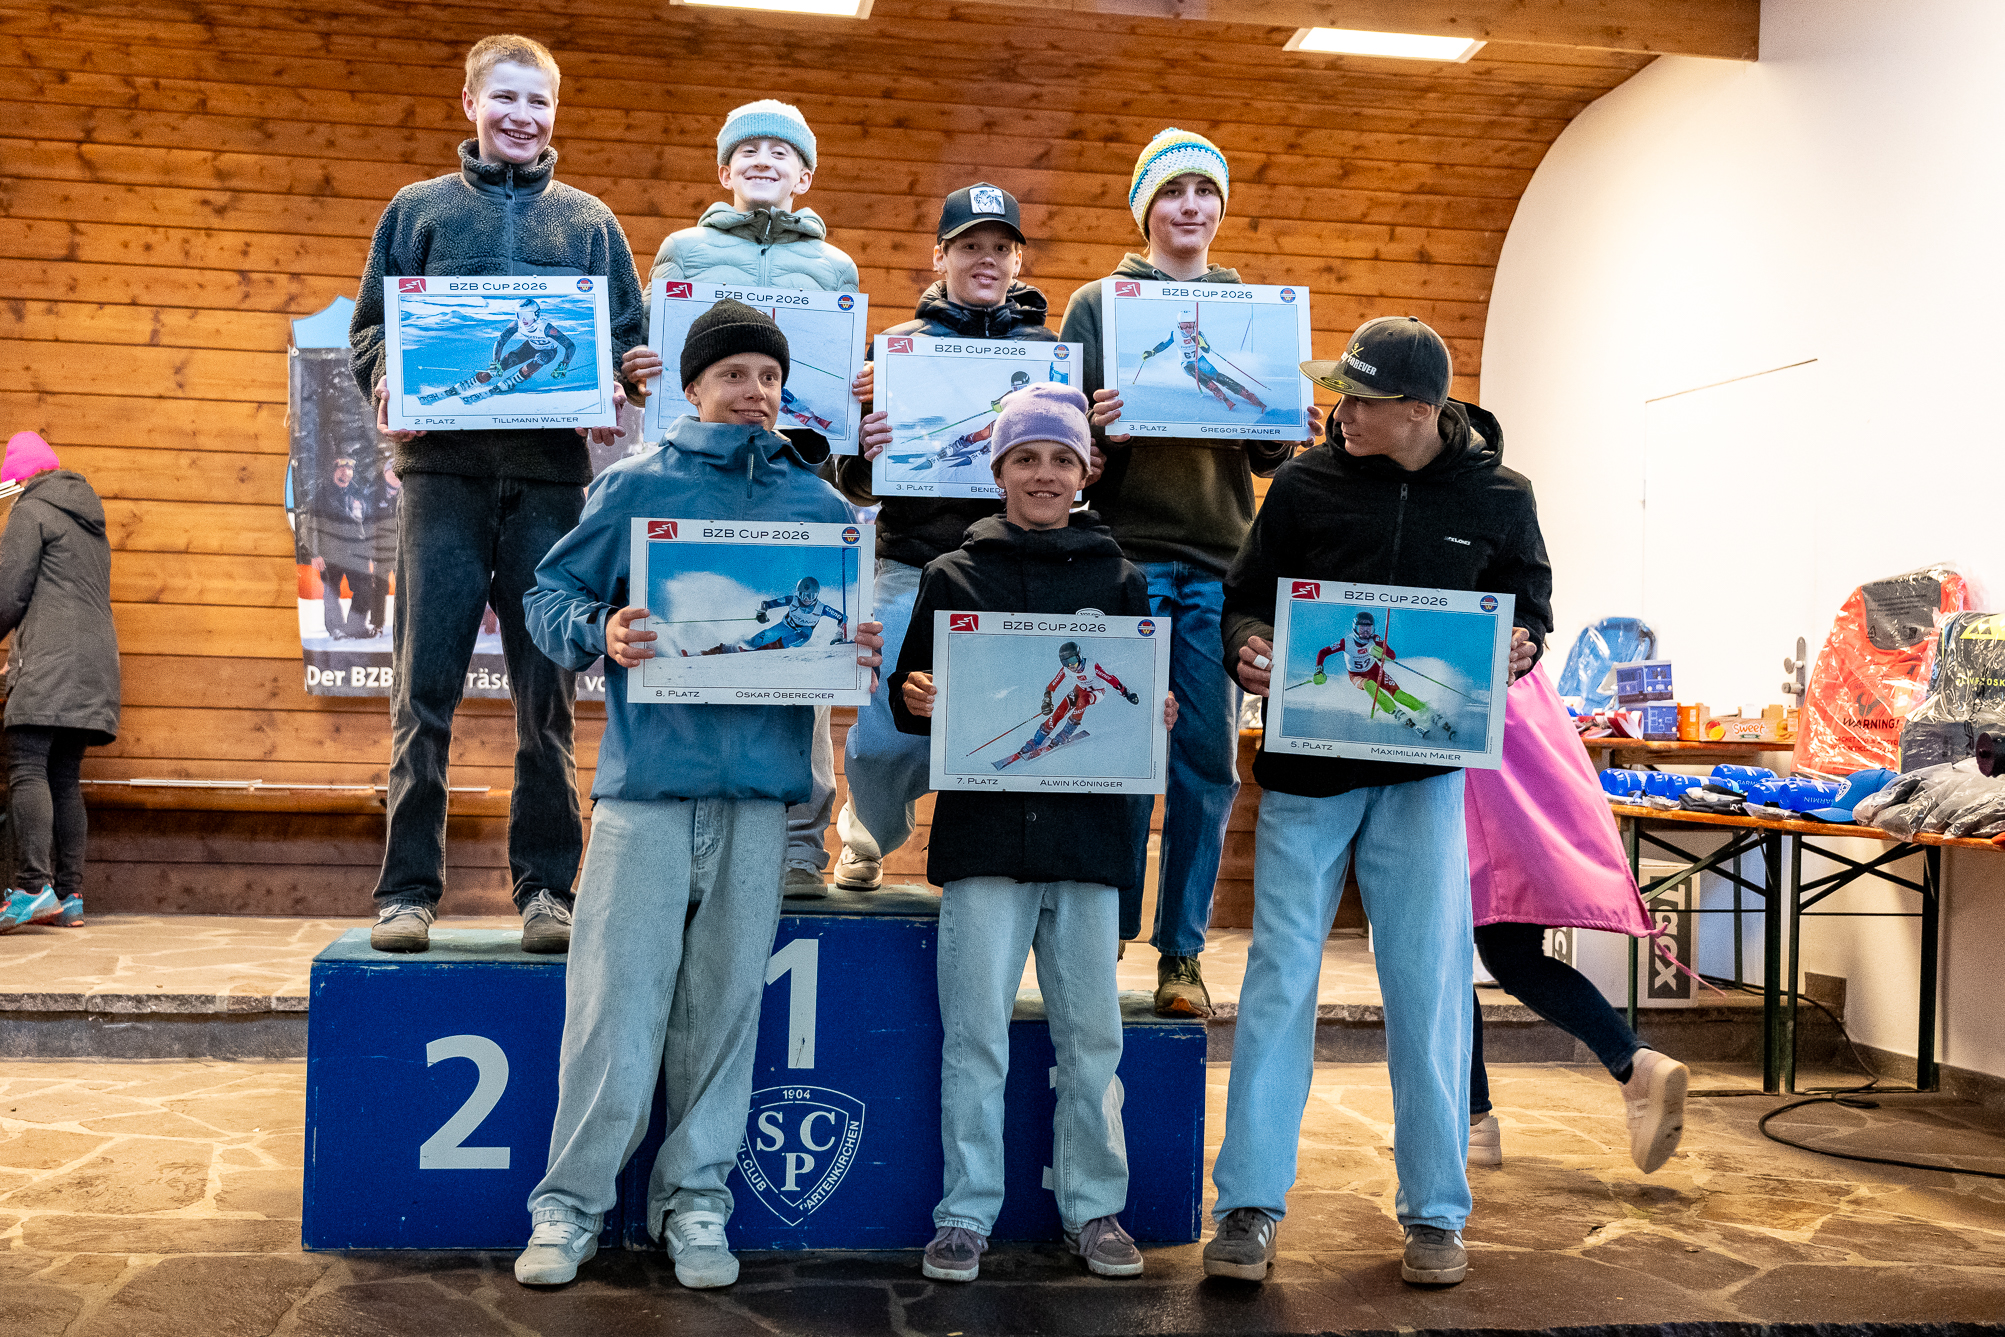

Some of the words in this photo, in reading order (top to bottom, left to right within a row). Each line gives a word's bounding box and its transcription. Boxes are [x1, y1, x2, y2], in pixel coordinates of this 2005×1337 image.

[449, 282, 479, 291] BZB
[482, 282, 510, 291] CUP
[513, 282, 548, 291] 2026
[714, 290, 743, 300] BZB
[746, 292, 774, 302] CUP
[776, 294, 810, 305] 2026
[1162, 288, 1189, 297] BZB
[1193, 289, 1219, 298] CUP
[1220, 290, 1253, 299] 2026
[934, 344, 962, 353] BZB
[965, 345, 992, 354] CUP
[993, 346, 1027, 356] 2026
[1347, 356, 1378, 376] FOREVER
[493, 416, 539, 424] TILLMANN
[540, 415, 579, 423] WALTER
[1200, 426, 1239, 434] GREGOR
[1240, 427, 1281, 435] STAUNER
[970, 486, 1002, 494] BENED
[703, 528, 735, 538] BZB
[739, 529, 769, 539] CUP
[772, 530, 810, 540] 2026
[1344, 590, 1375, 601] BZB
[1379, 592, 1409, 603] CUP
[1411, 595, 1448, 606] 2026
[1003, 621, 1034, 631] BZB
[1037, 622, 1067, 632] CUP
[1070, 622, 1107, 633] 2026
[307, 664, 346, 687] Der
[351, 666, 394, 688] BZB
[584, 675, 606, 692] vo
[668, 690, 700, 698] PLATZ
[735, 690, 771, 699] OSKAR
[773, 691, 835, 699] OBERECKER
[1733, 722, 1767, 734] Sweet
[1843, 717, 1900, 730] WARNING!
[1290, 741, 1300, 749] 5.
[1302, 741, 1333, 751] PLATZ
[1371, 748, 1427, 759] MAXIMILIAN
[1429, 751, 1461, 761] MAIER
[956, 777, 966, 785] 7.
[967, 777, 999, 785] PLATZ
[1040, 779, 1070, 787] ALWIN
[1072, 778, 1123, 788] KÖNINGER
[764, 937, 819, 1069] 1
[782, 1089, 811, 1099] 1904
[419, 1034, 511, 1170] 2
